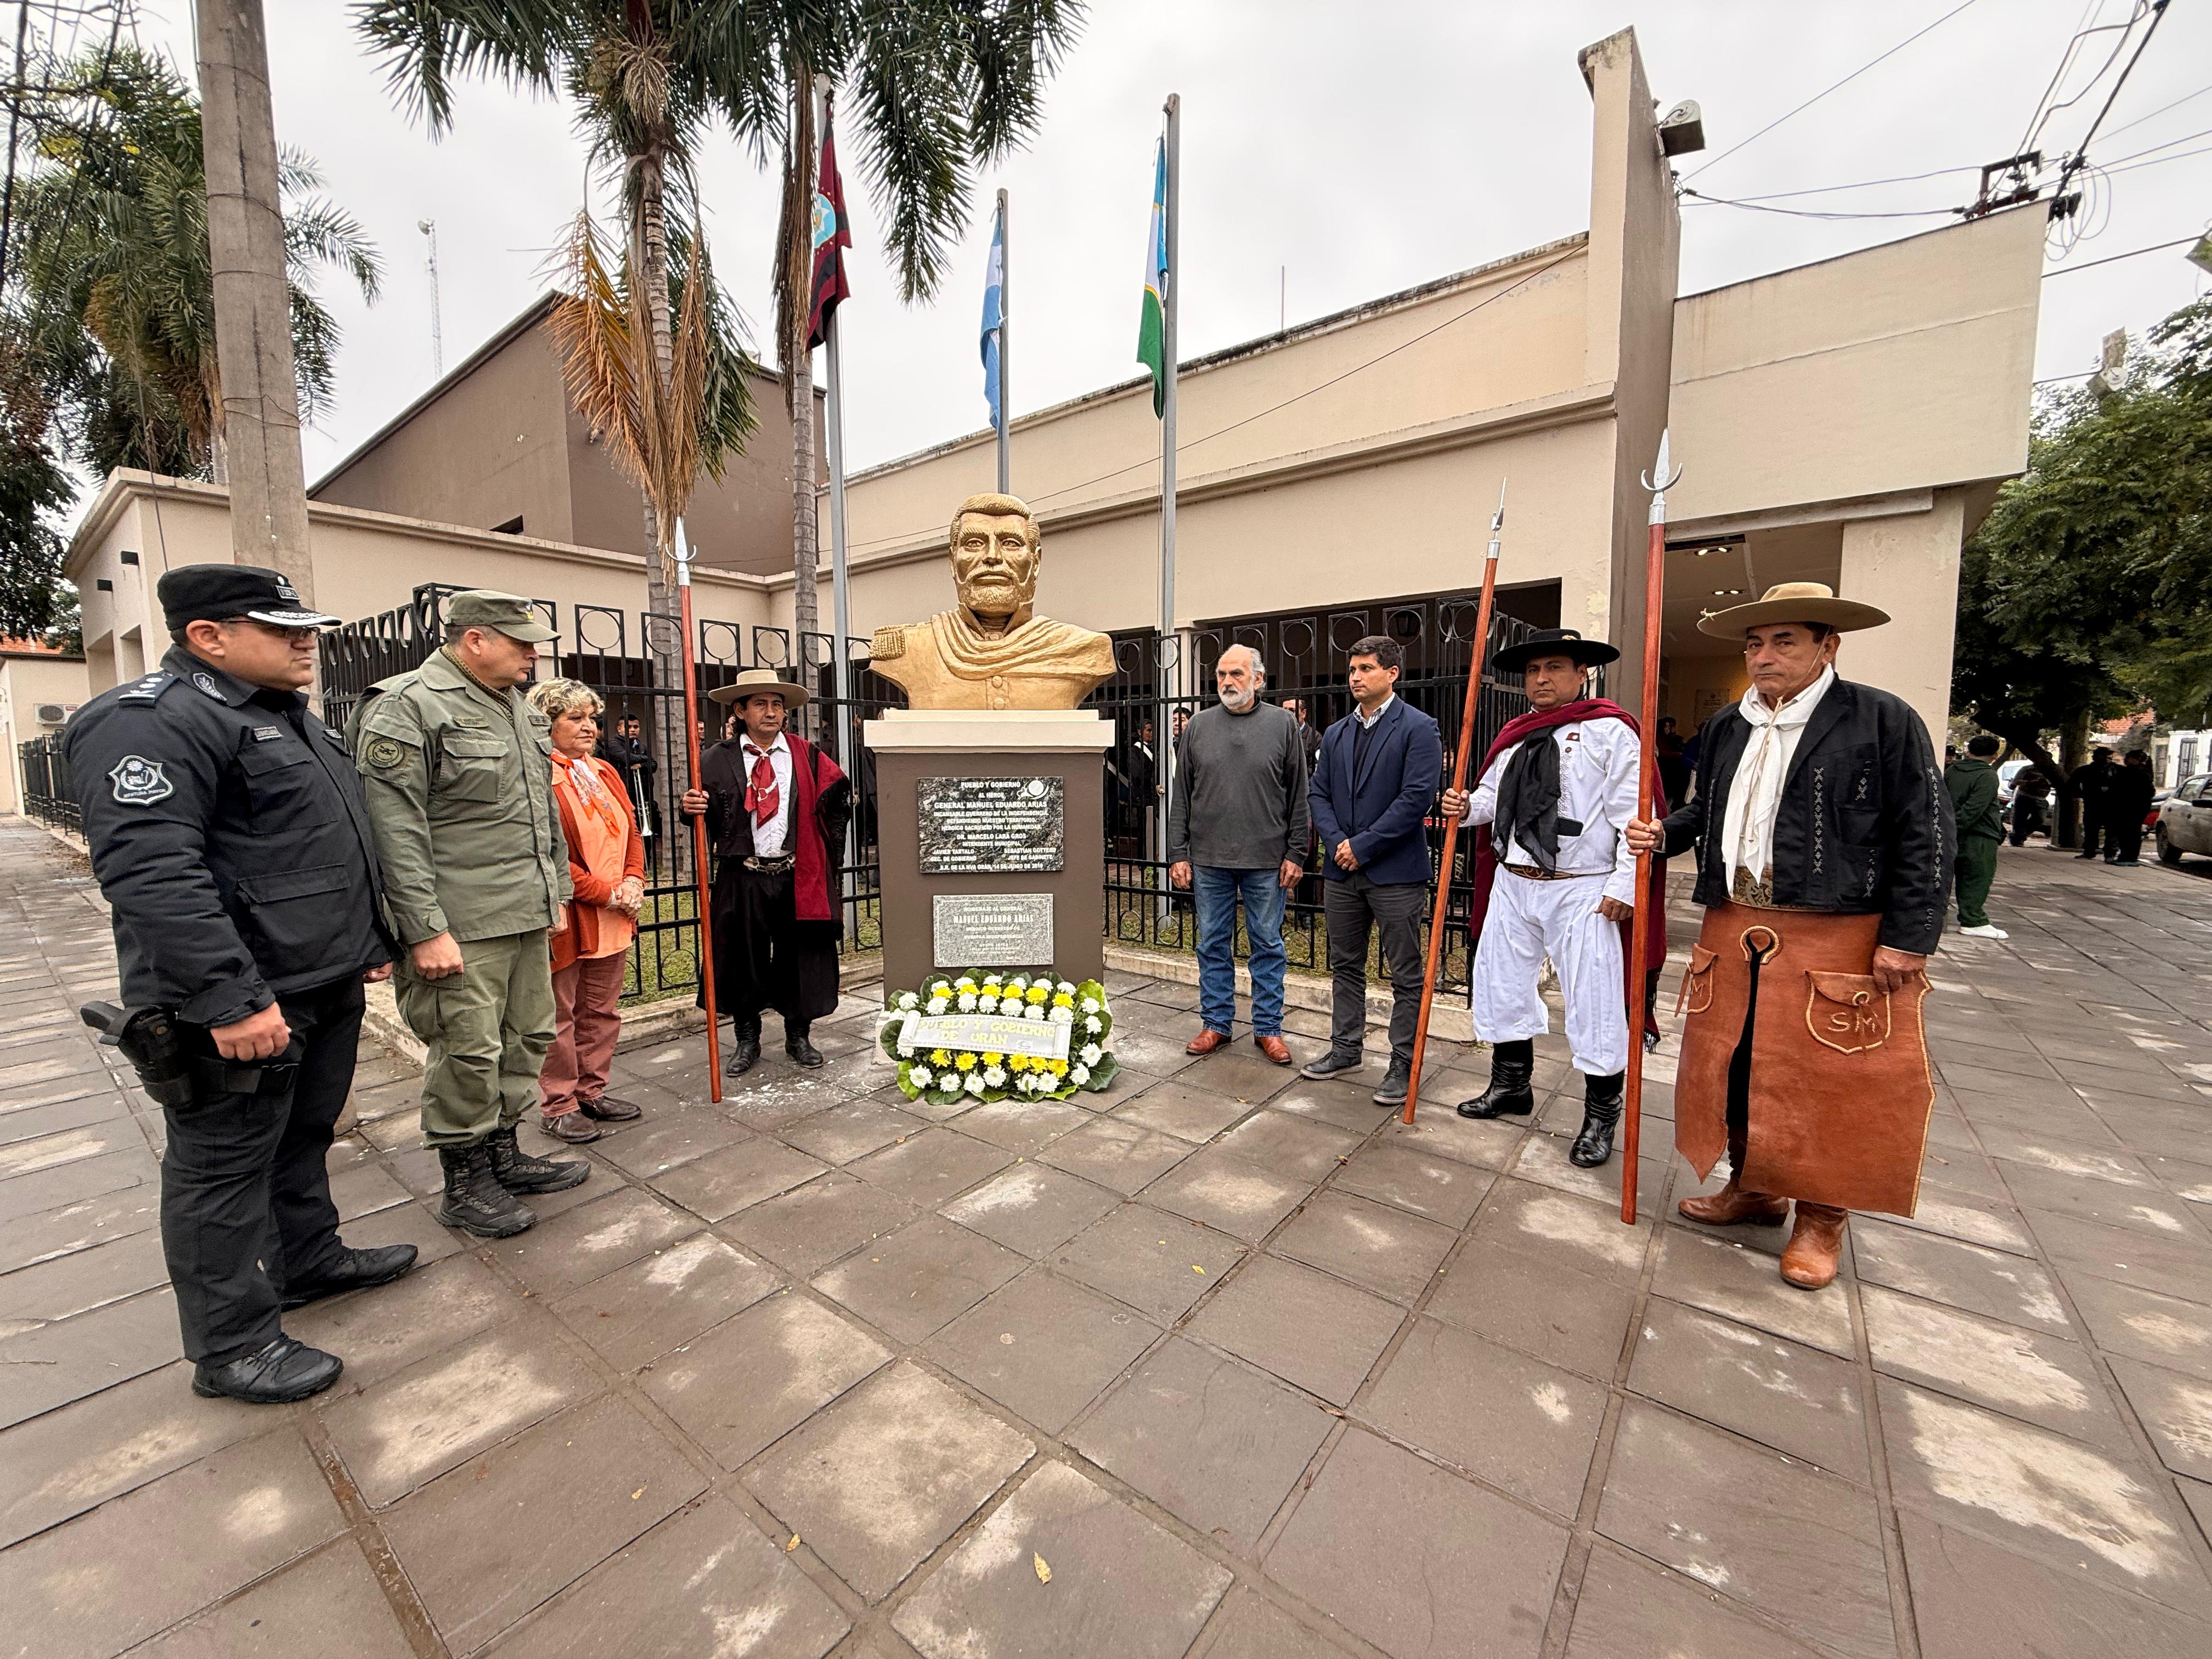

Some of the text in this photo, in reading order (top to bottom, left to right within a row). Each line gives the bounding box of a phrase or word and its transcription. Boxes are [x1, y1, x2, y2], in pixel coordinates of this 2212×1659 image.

[953, 914, 1034, 923] MANUEL EDUARDO ARIAS
[918, 1019, 1056, 1037] PUEBLO Y GOBIERNO
[940, 1030, 959, 1041] DE
